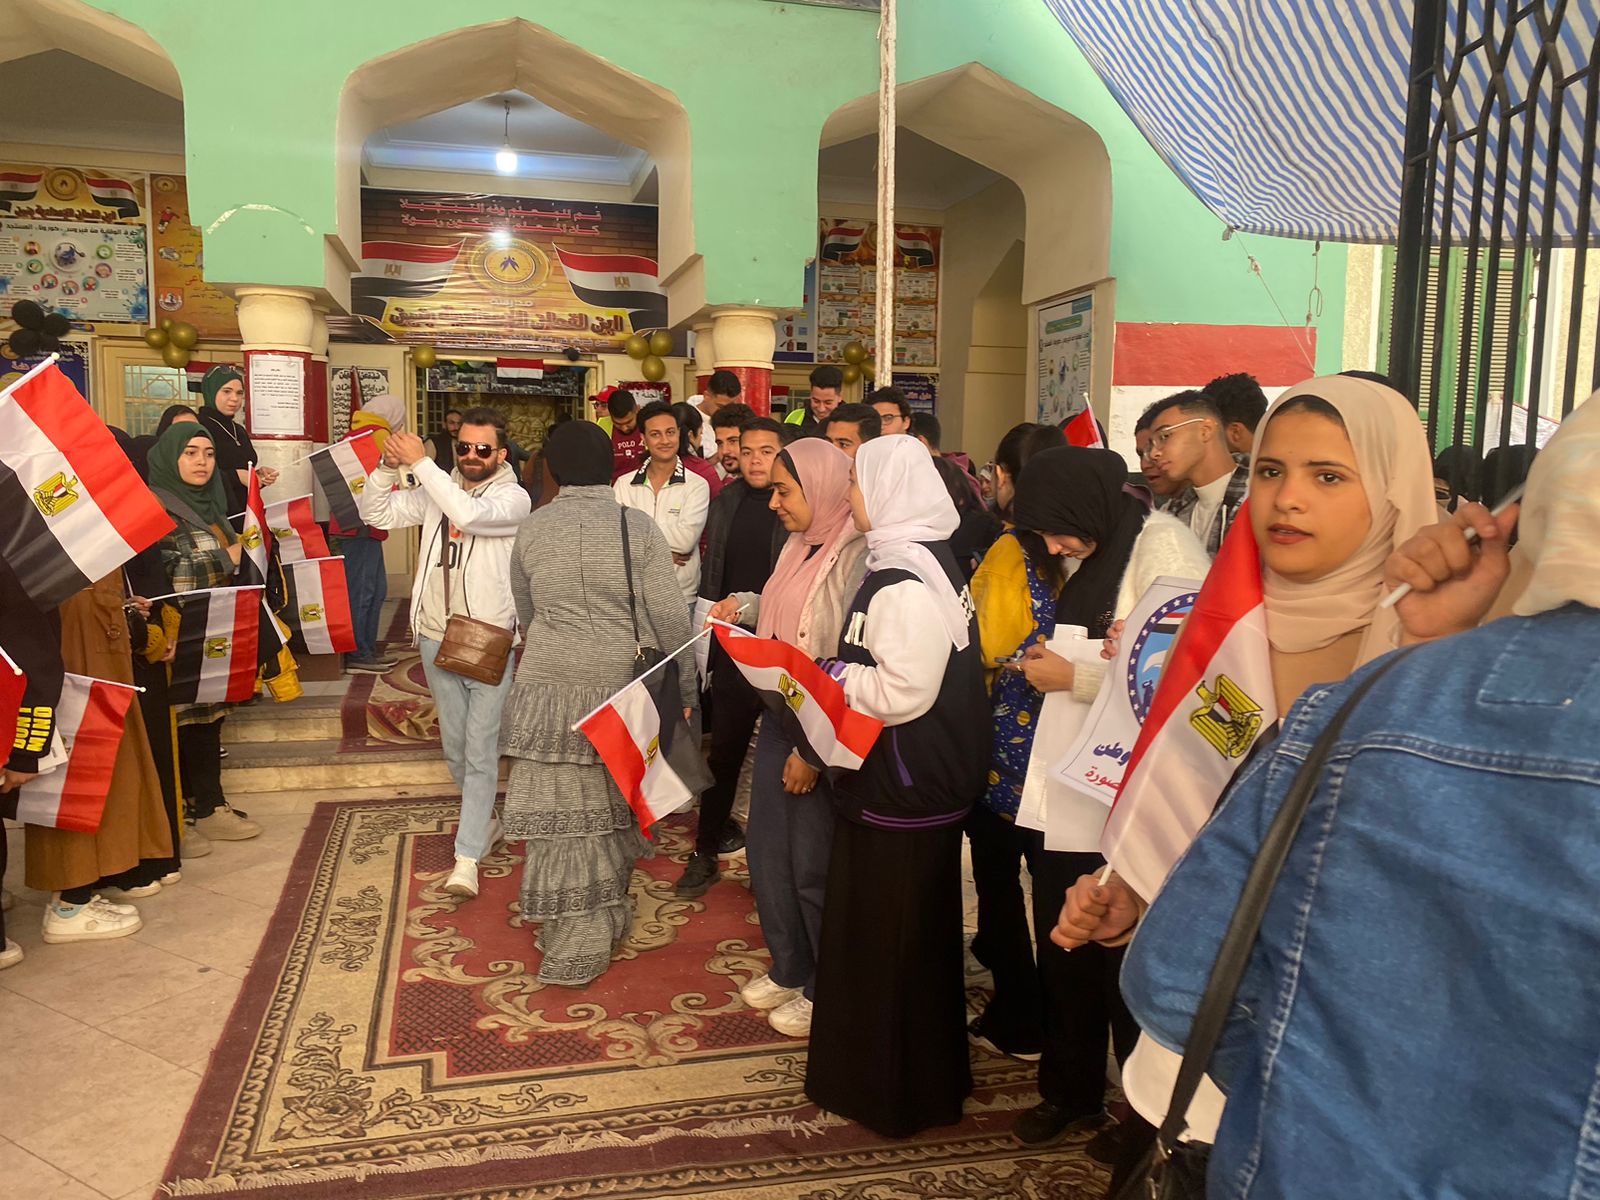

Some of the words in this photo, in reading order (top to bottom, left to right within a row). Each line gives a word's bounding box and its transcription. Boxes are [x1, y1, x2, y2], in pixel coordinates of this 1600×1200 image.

[617, 440, 636, 450] POLO
[26, 706, 53, 752] MIND
[1084, 766, 1121, 791] صورة
